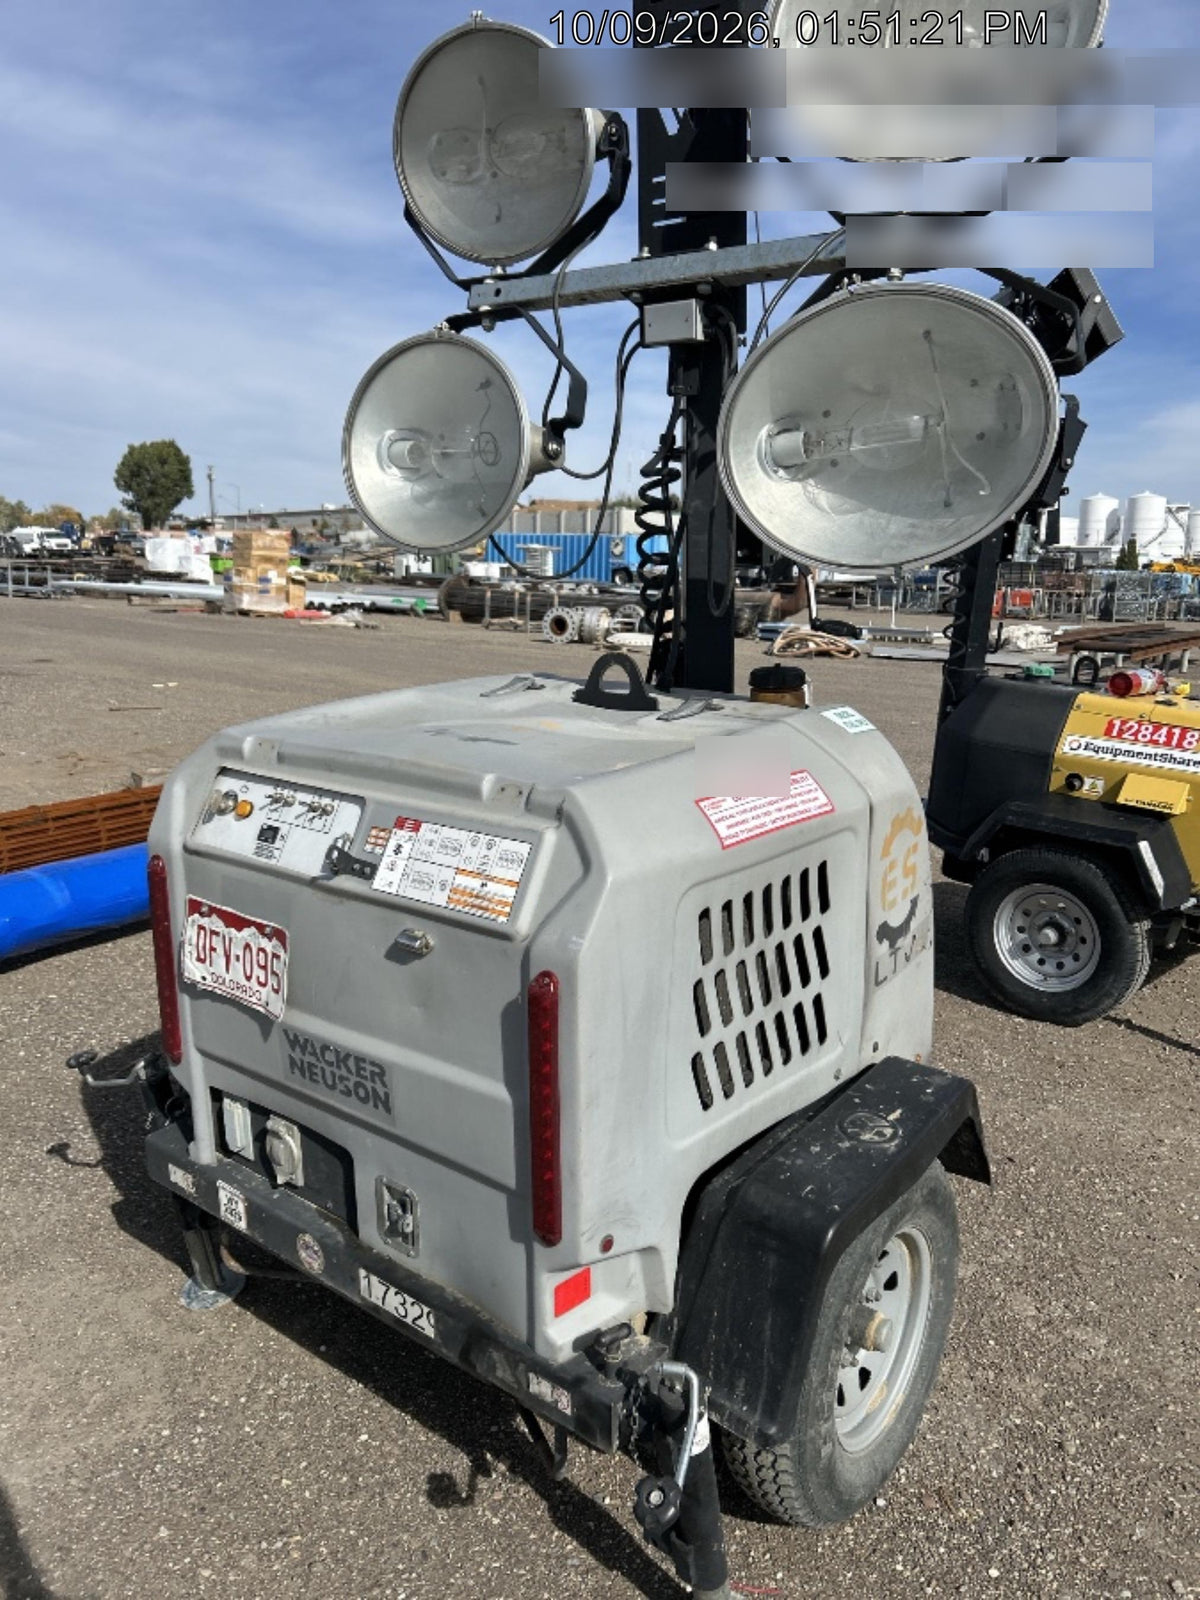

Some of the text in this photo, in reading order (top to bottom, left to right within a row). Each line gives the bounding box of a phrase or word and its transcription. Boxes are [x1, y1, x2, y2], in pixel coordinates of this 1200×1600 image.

[1110, 719, 1200, 750] 128418
[195, 924, 282, 995] DFV-095
[210, 971, 262, 1002] COLORADO
[282, 1028, 389, 1090] WACKER
[288, 1053, 392, 1116] NEUSON
